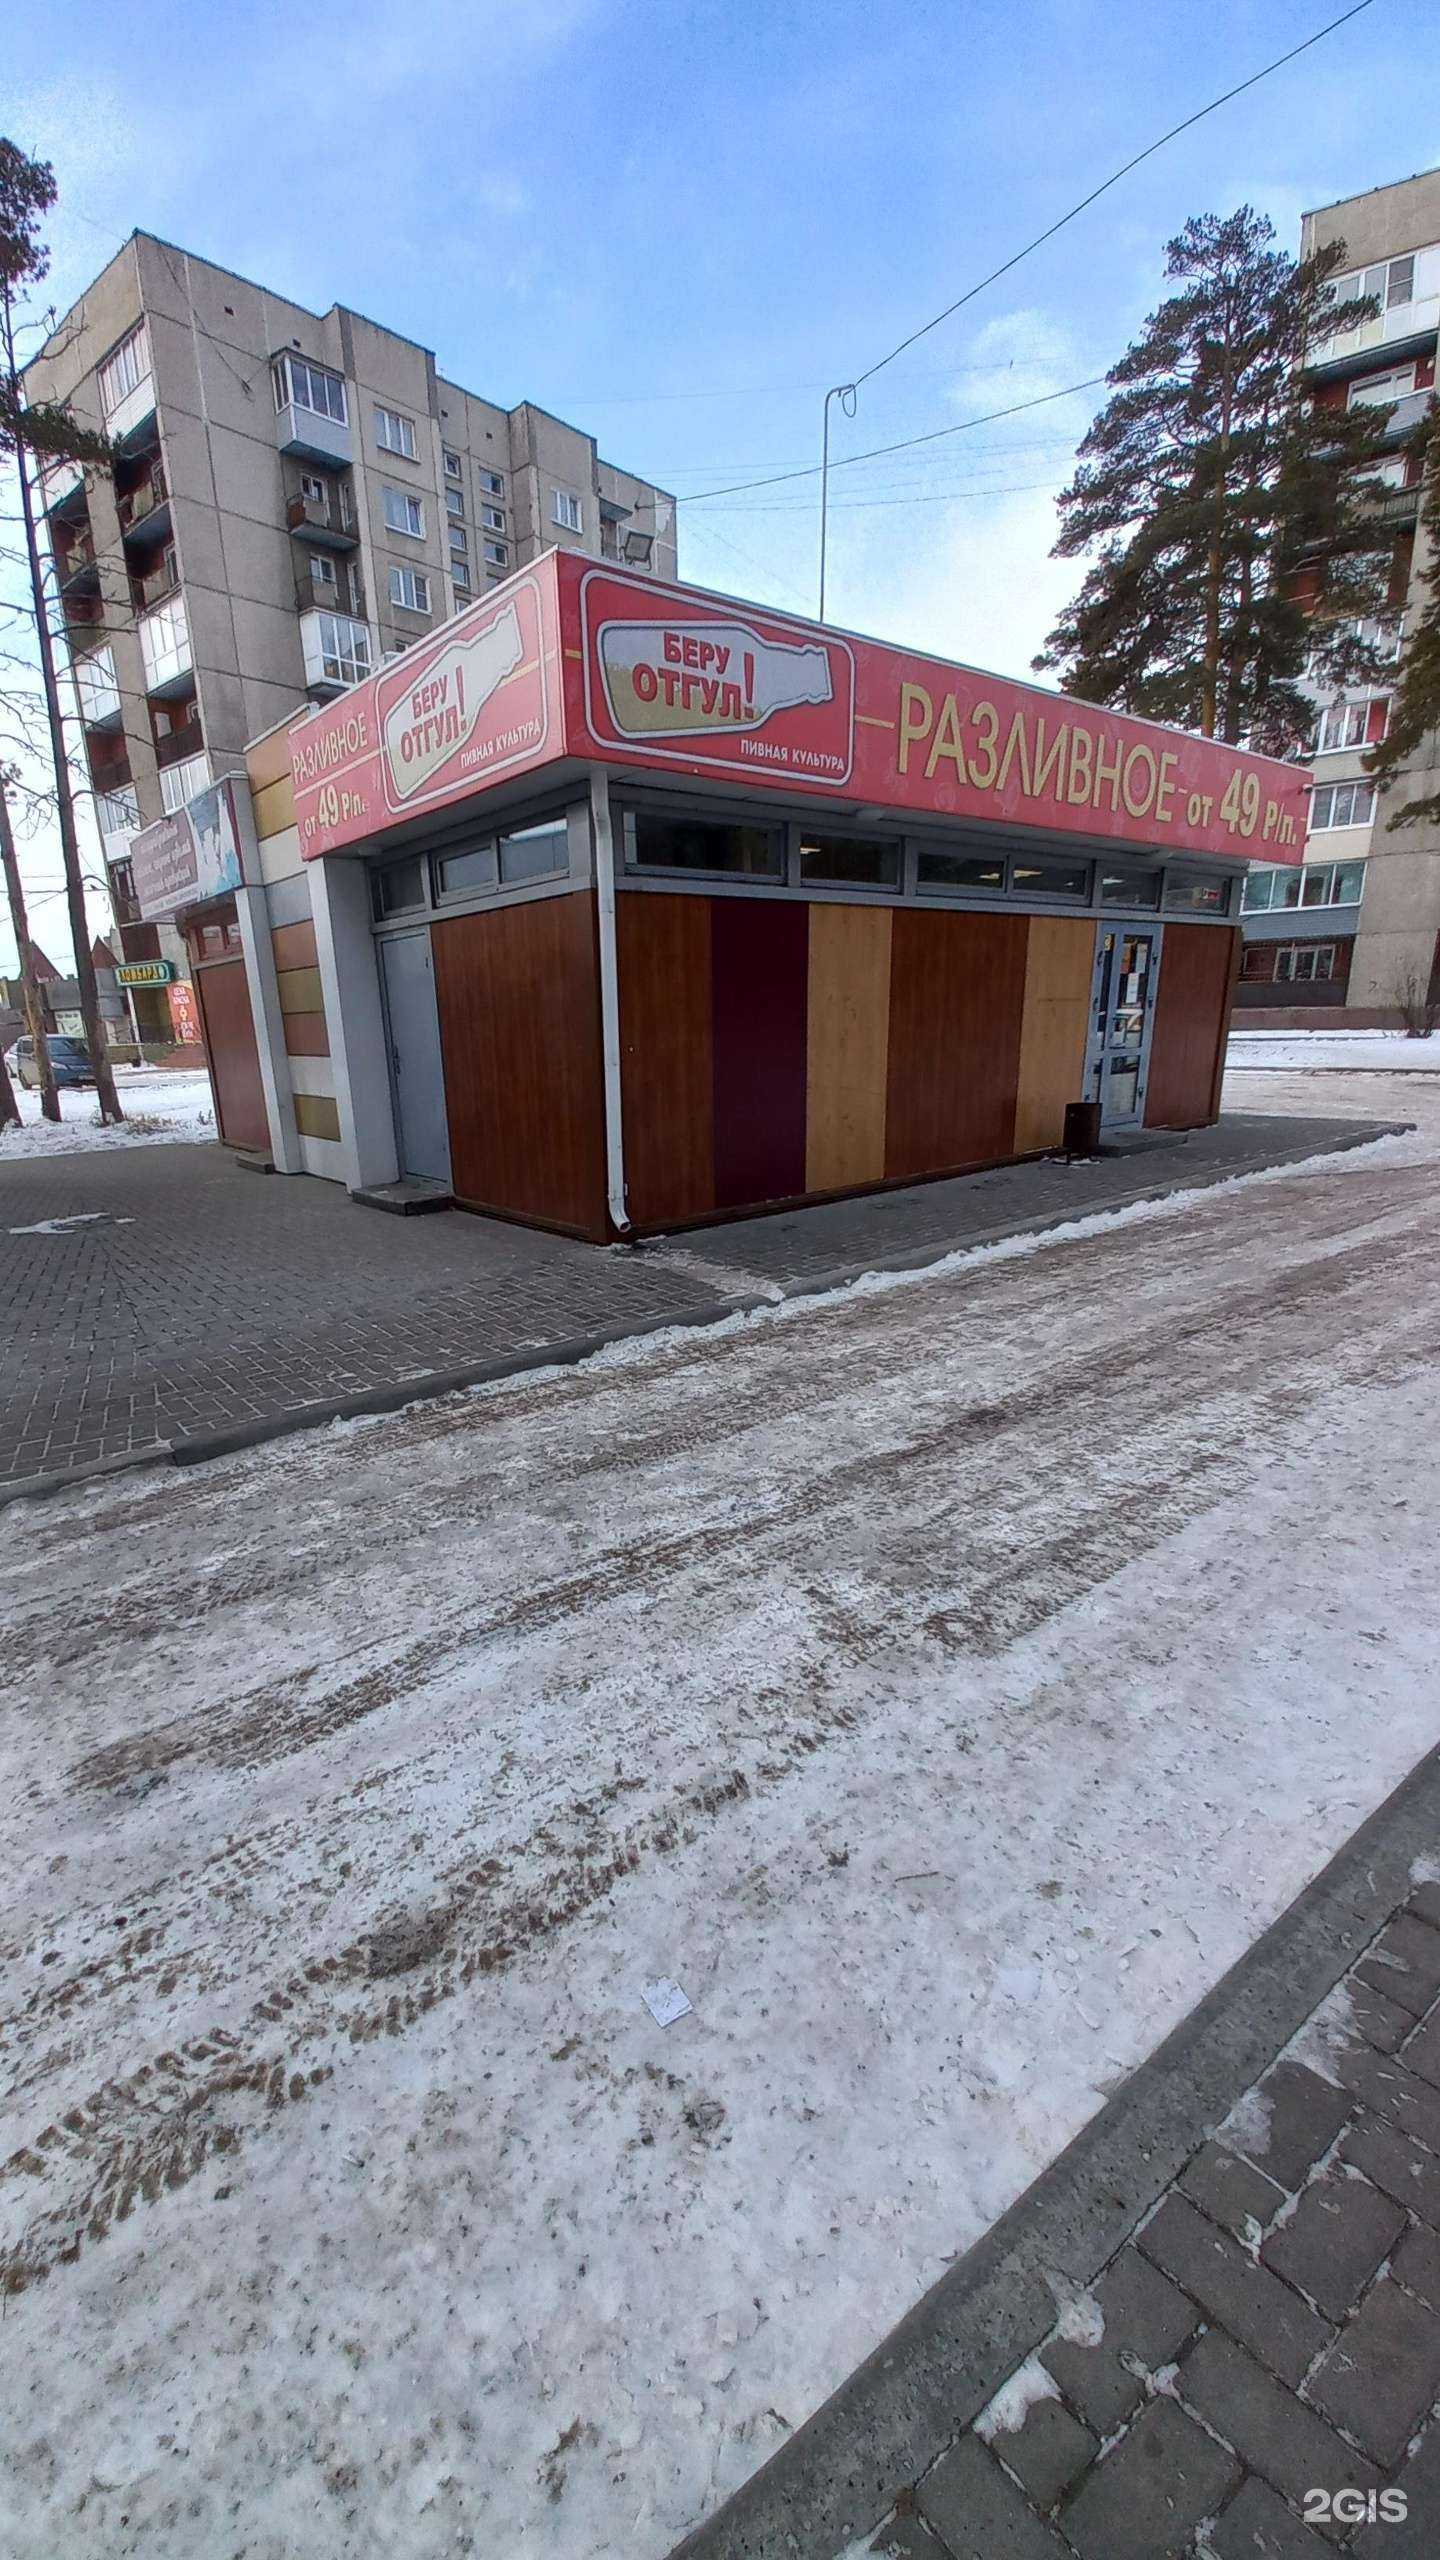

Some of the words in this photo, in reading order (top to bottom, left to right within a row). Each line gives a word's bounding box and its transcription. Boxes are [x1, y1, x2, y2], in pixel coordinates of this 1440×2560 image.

[664, 632, 730, 674] БЕРУ
[411, 674, 448, 720] БЕРУ
[632, 653, 755, 720] ОТГУЛ!
[400, 664, 466, 763] ОТГУЛ!
[292, 712, 367, 785] РАЗЛИВНОЕ
[461, 740, 494, 768] ПИВНАЯ
[495, 717, 541, 752] КУЛЬТУРА
[740, 738, 788, 762] ПИВНАЯ
[792, 749, 845, 772] КУЛЬТУРА
[897, 681, 1179, 823] РАЗЛИВНОЕ
[1219, 768, 1260, 838] 49
[319, 784, 340, 829] 49
